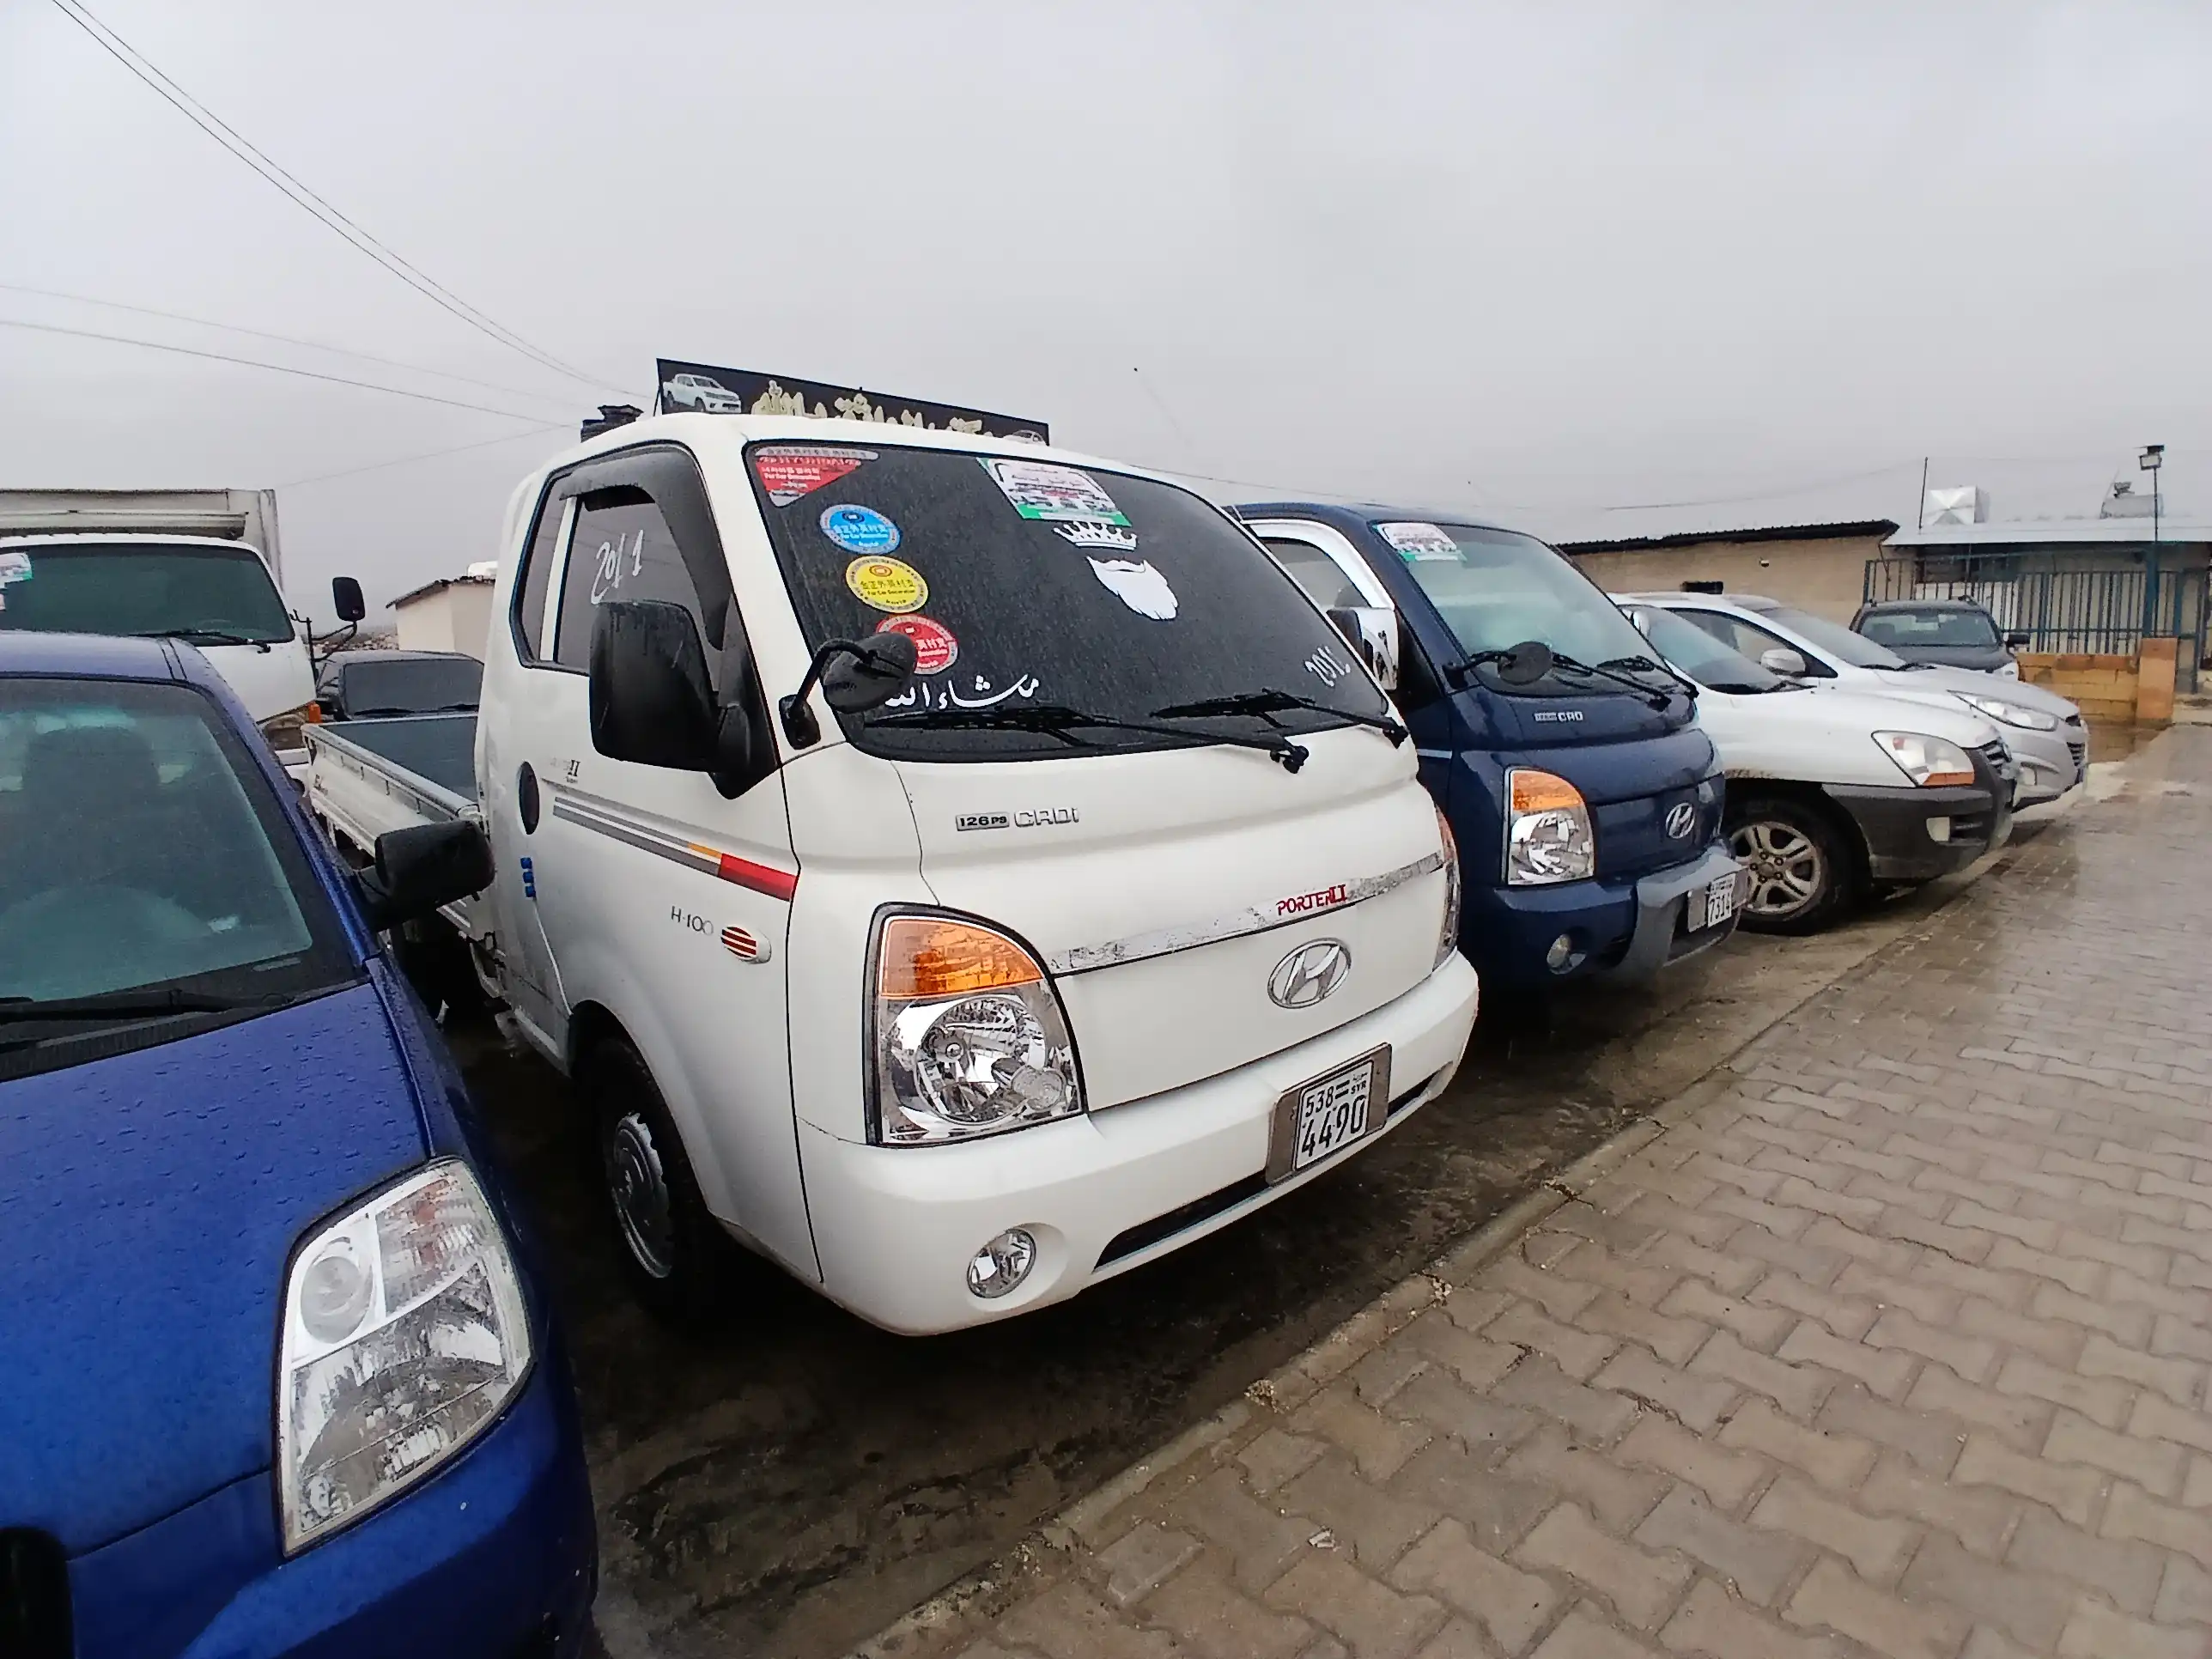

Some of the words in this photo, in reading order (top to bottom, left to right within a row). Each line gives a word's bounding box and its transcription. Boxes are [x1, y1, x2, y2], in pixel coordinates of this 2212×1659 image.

[1304, 1085, 1334, 1118] 538
[1351, 1079, 1367, 1095] SYR
[1301, 1094, 1367, 1158] 4490
